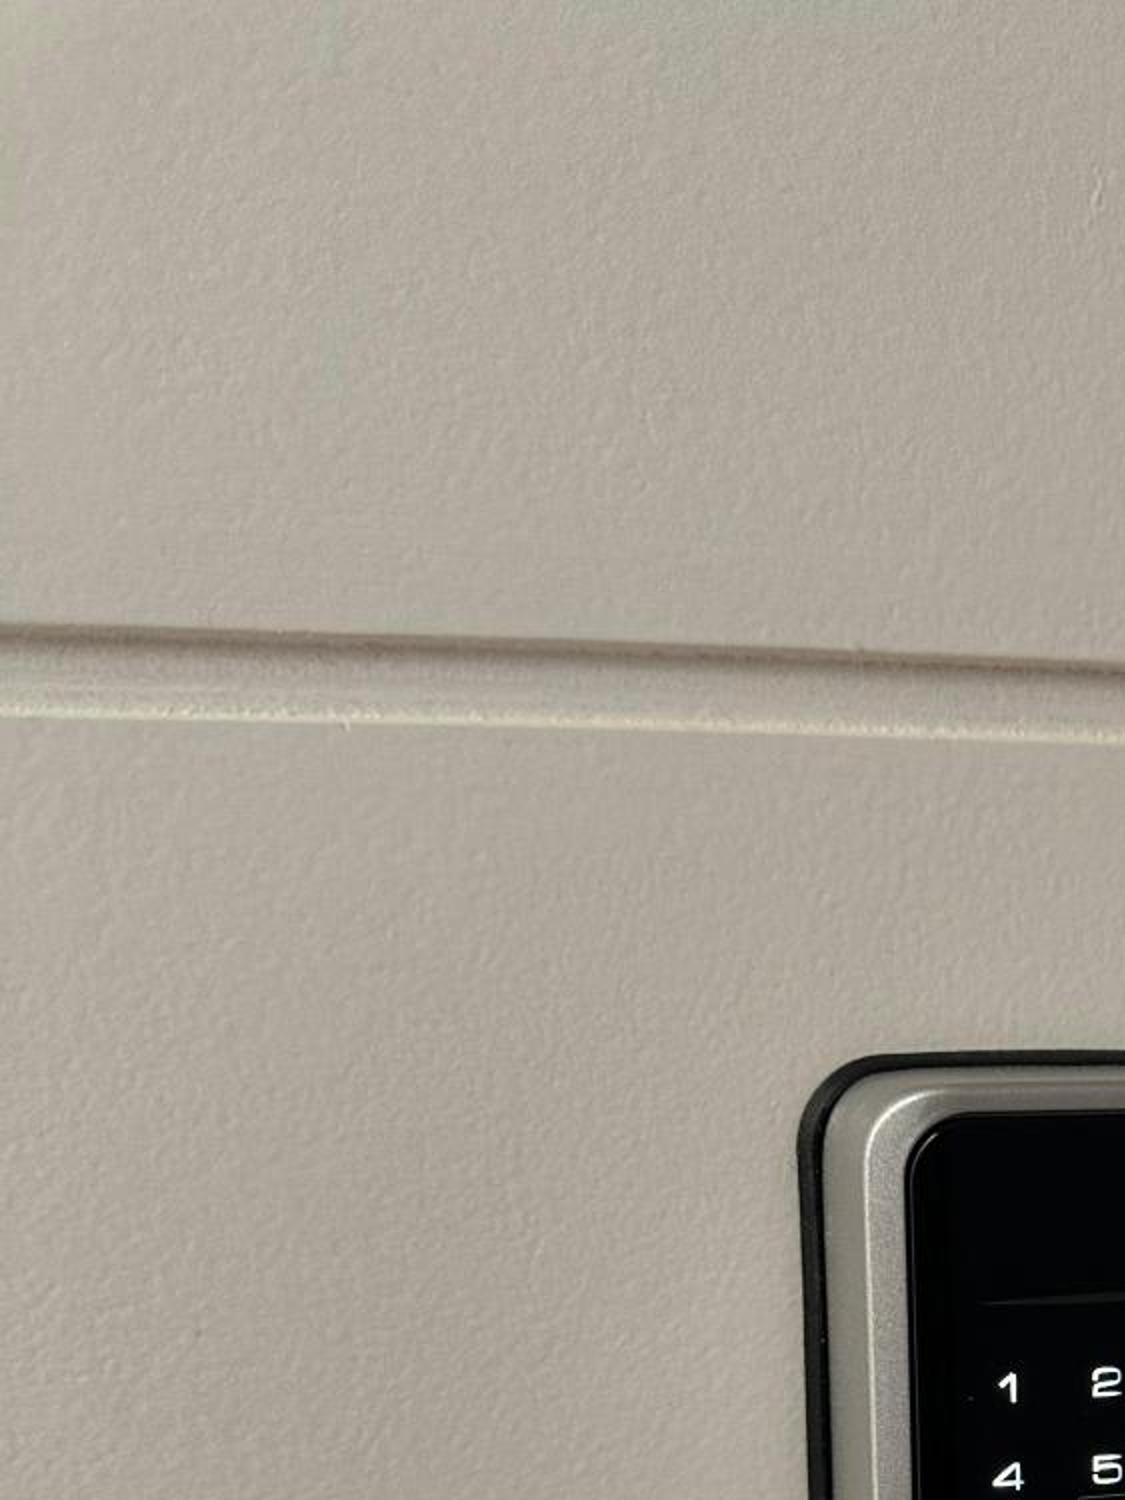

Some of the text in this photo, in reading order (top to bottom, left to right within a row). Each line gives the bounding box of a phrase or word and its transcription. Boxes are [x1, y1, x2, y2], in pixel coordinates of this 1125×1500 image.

[997, 1371, 1017, 1404] 1
[1091, 1366, 1122, 1398] 2
[991, 1461, 1025, 1491] 4
[1091, 1453, 1123, 1485] 5
